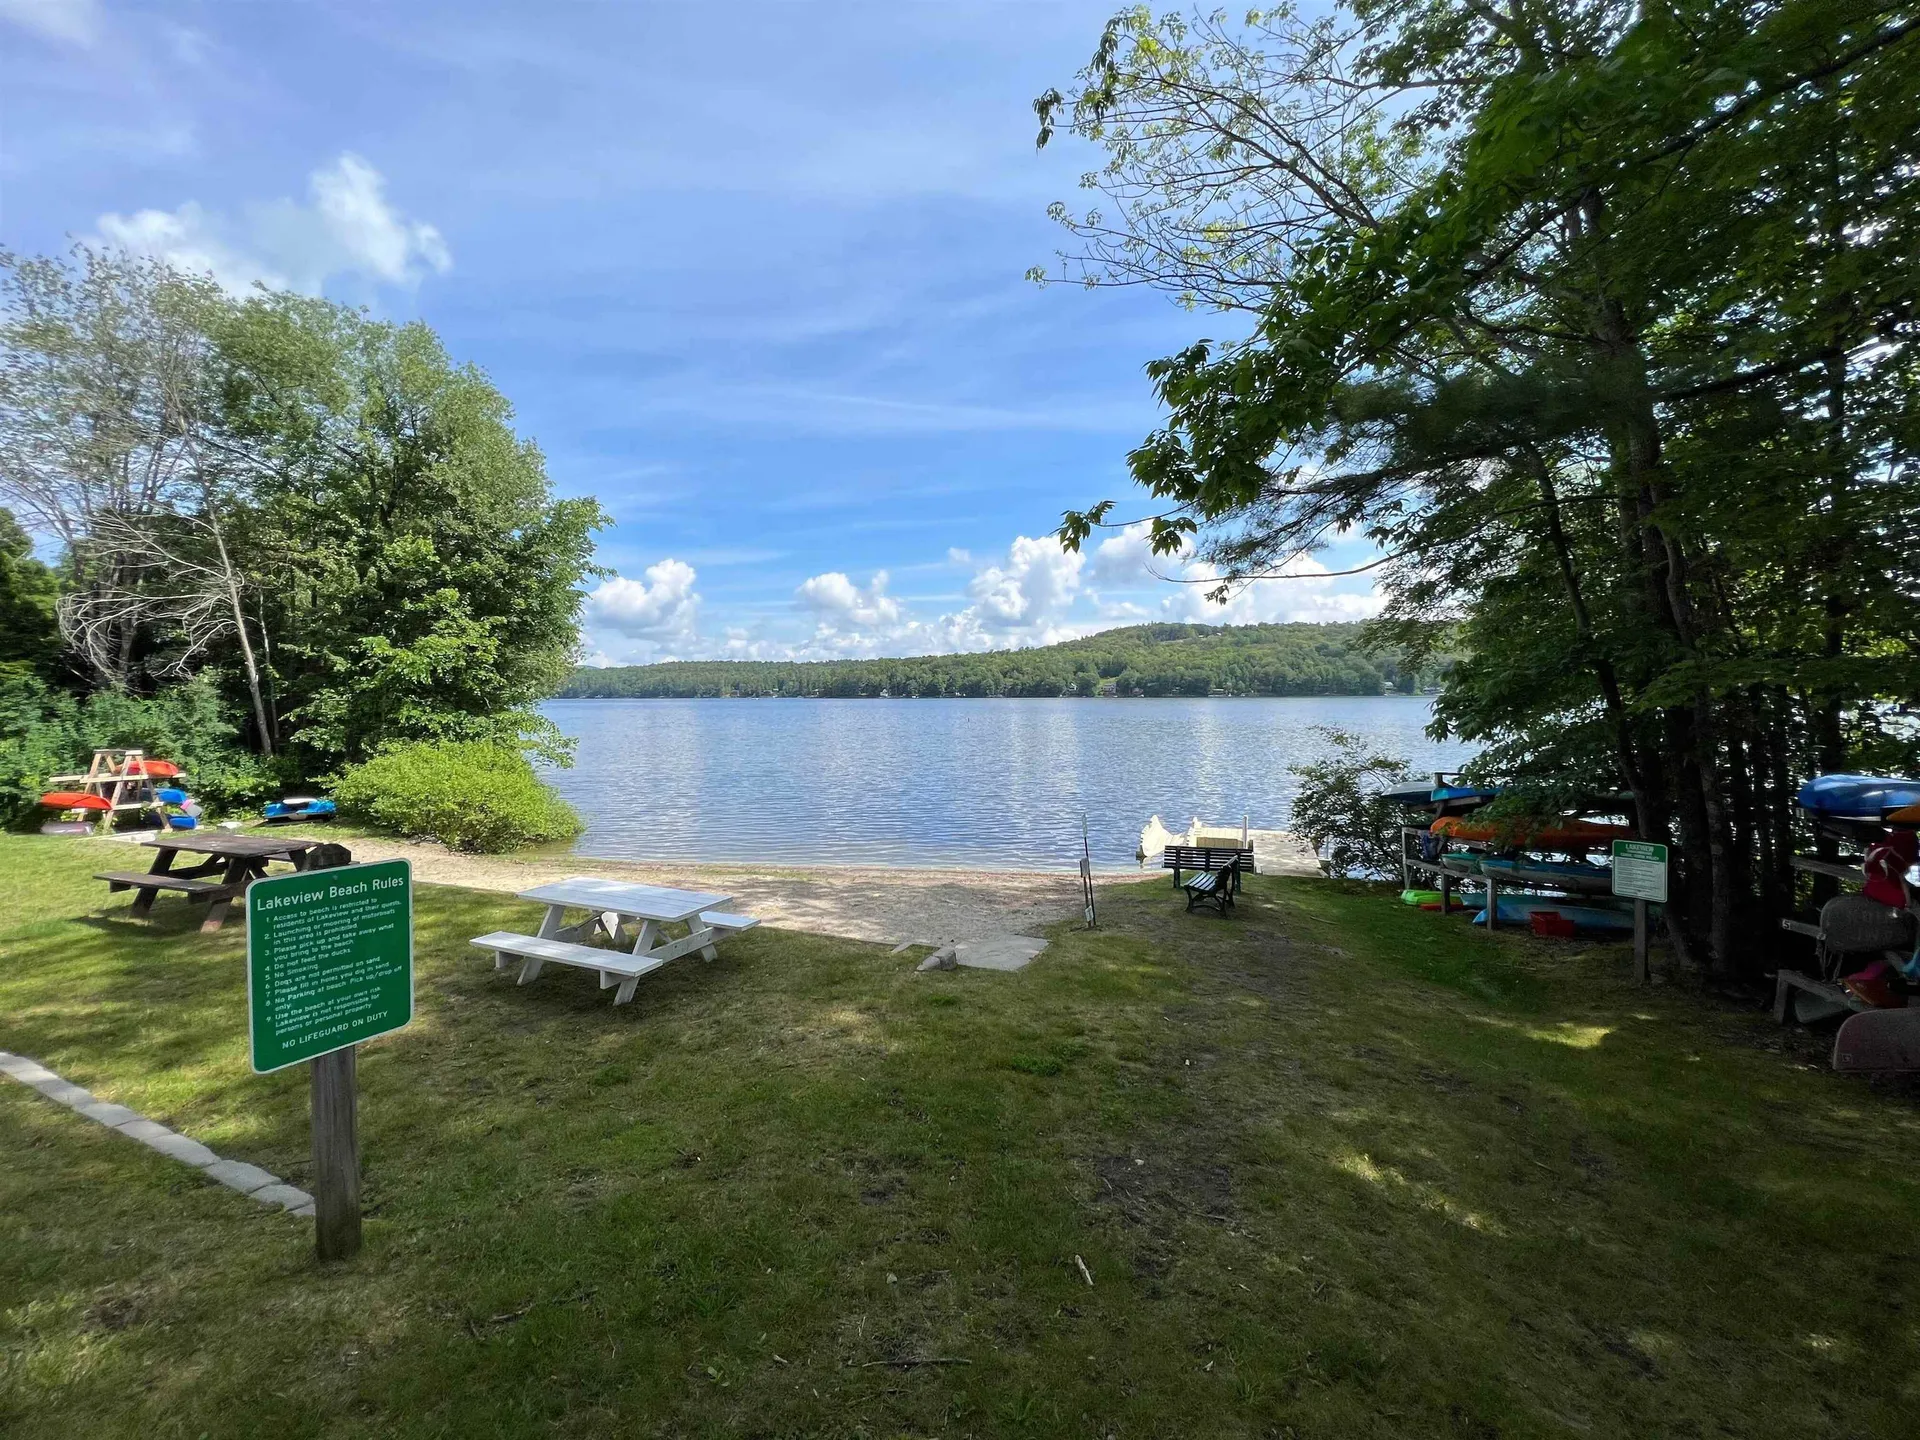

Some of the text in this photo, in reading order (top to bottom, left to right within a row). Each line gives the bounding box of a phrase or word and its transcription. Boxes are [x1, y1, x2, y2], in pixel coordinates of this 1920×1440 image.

[257, 877, 404, 911] Lakeview Beach Rules
[273, 913, 298, 921] Access
[340, 899, 369, 909] restricted
[273, 918, 305, 930] residents
[317, 910, 349, 921] Lakeview
[273, 926, 311, 938] Launching
[323, 918, 351, 927] mooring
[362, 909, 395, 920] motorboats
[274, 945, 296, 953] Please
[274, 954, 288, 962] you
[291, 949, 309, 958] bring
[274, 978, 292, 987] Dogs
[322, 963, 353, 976] permitted
[275, 986, 298, 995] Please
[321, 975, 338, 984] holes
[288, 990, 316, 1000] Parking
[366, 969, 392, 980] up/drop
[276, 1014, 310, 1028] Lakeview
[334, 997, 369, 1010] responsible
[305, 1002, 325, 1012] beach
[337, 995, 351, 1003] your
[276, 1024, 303, 1036] persons
[315, 1011, 343, 1024] personal
[282, 1010, 388, 1049] NO LIFEGUARD ON DUTY
